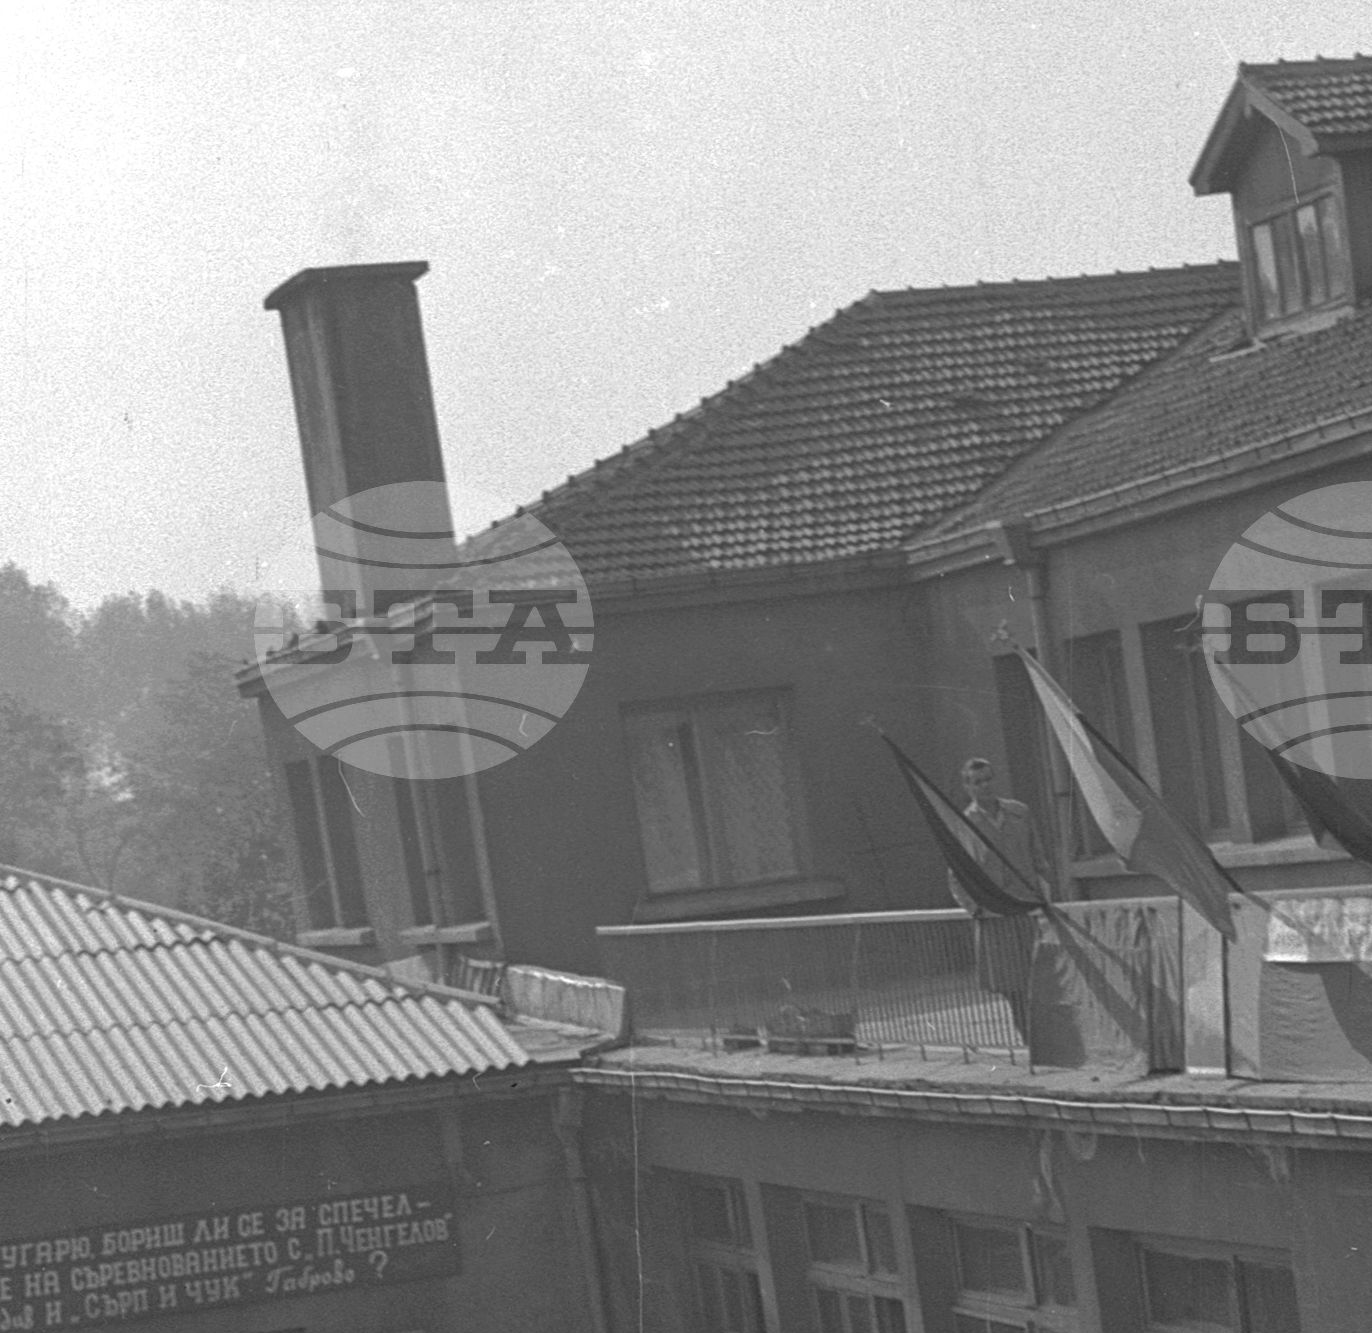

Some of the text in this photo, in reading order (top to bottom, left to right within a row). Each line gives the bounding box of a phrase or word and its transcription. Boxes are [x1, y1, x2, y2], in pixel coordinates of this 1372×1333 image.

[101, 1221, 185, 1256] БОРИШ
[194, 1213, 229, 1243] ЛИ
[237, 1209, 264, 1238] СЕ
[276, 1205, 306, 1234] ЗА
[25, 1269, 60, 1297] НА
[71, 1240, 278, 1293] СЪРЕВНОВАНИЕТО
[287, 1237, 301, 1261] С
[45, 1301, 62, 1325] И
[159, 1283, 177, 1309] И
